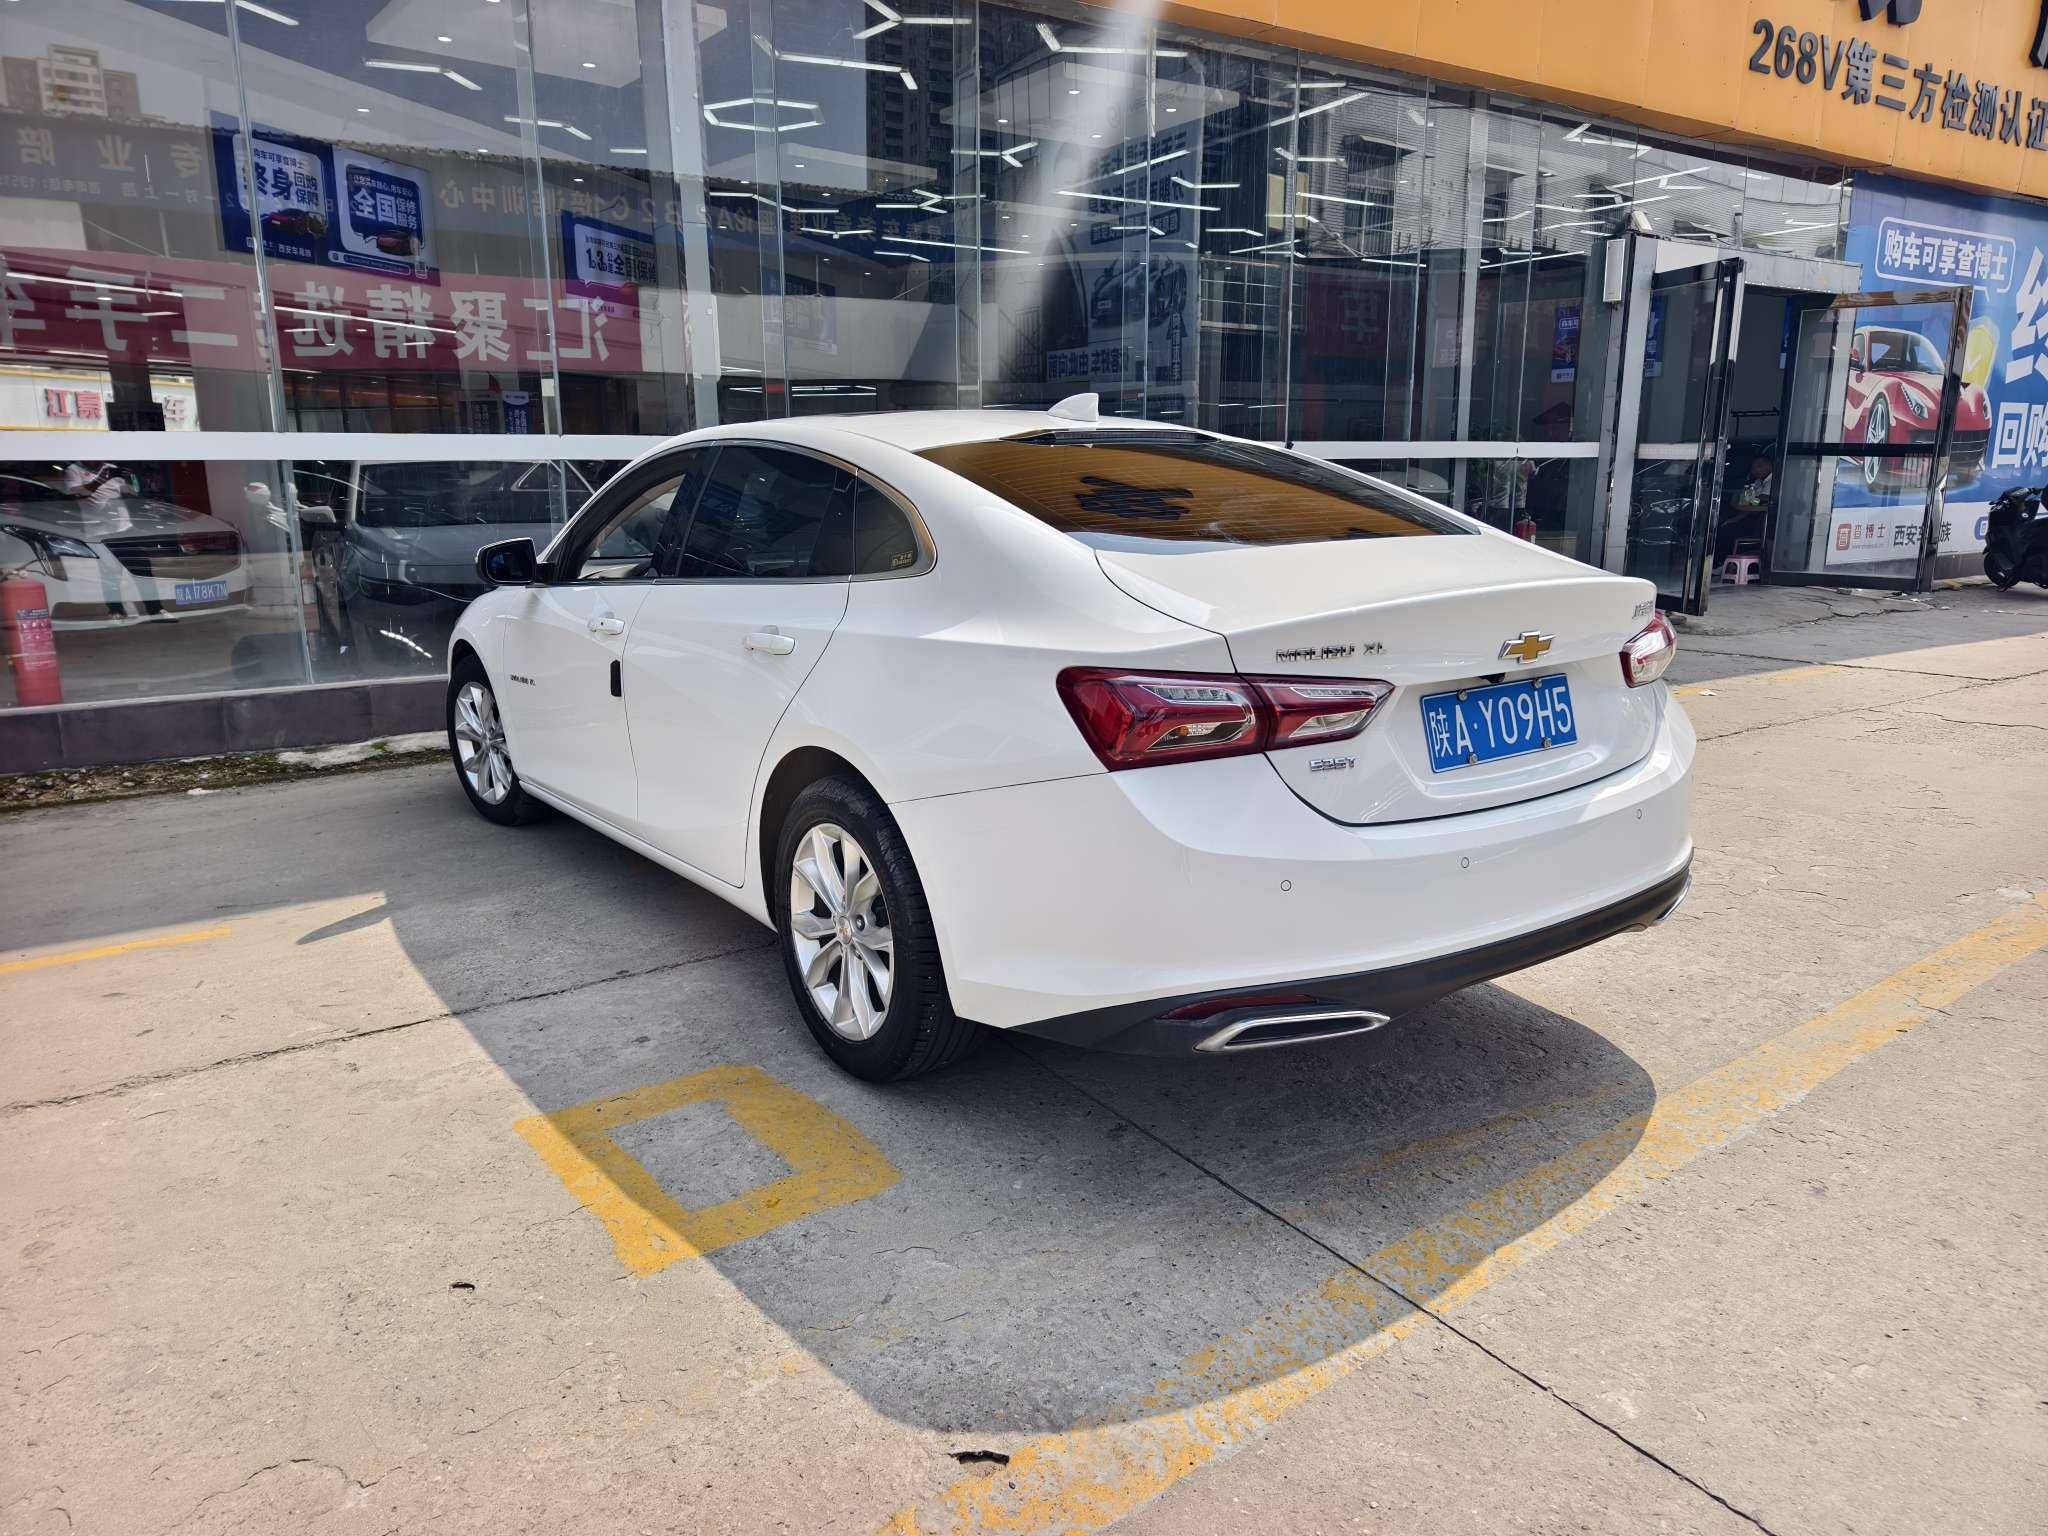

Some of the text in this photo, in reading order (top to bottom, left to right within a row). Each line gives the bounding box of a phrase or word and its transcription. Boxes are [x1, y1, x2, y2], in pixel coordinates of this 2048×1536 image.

[353, 188, 397, 226] 全国
[1883, 228, 2008, 281] 购车可享查博士
